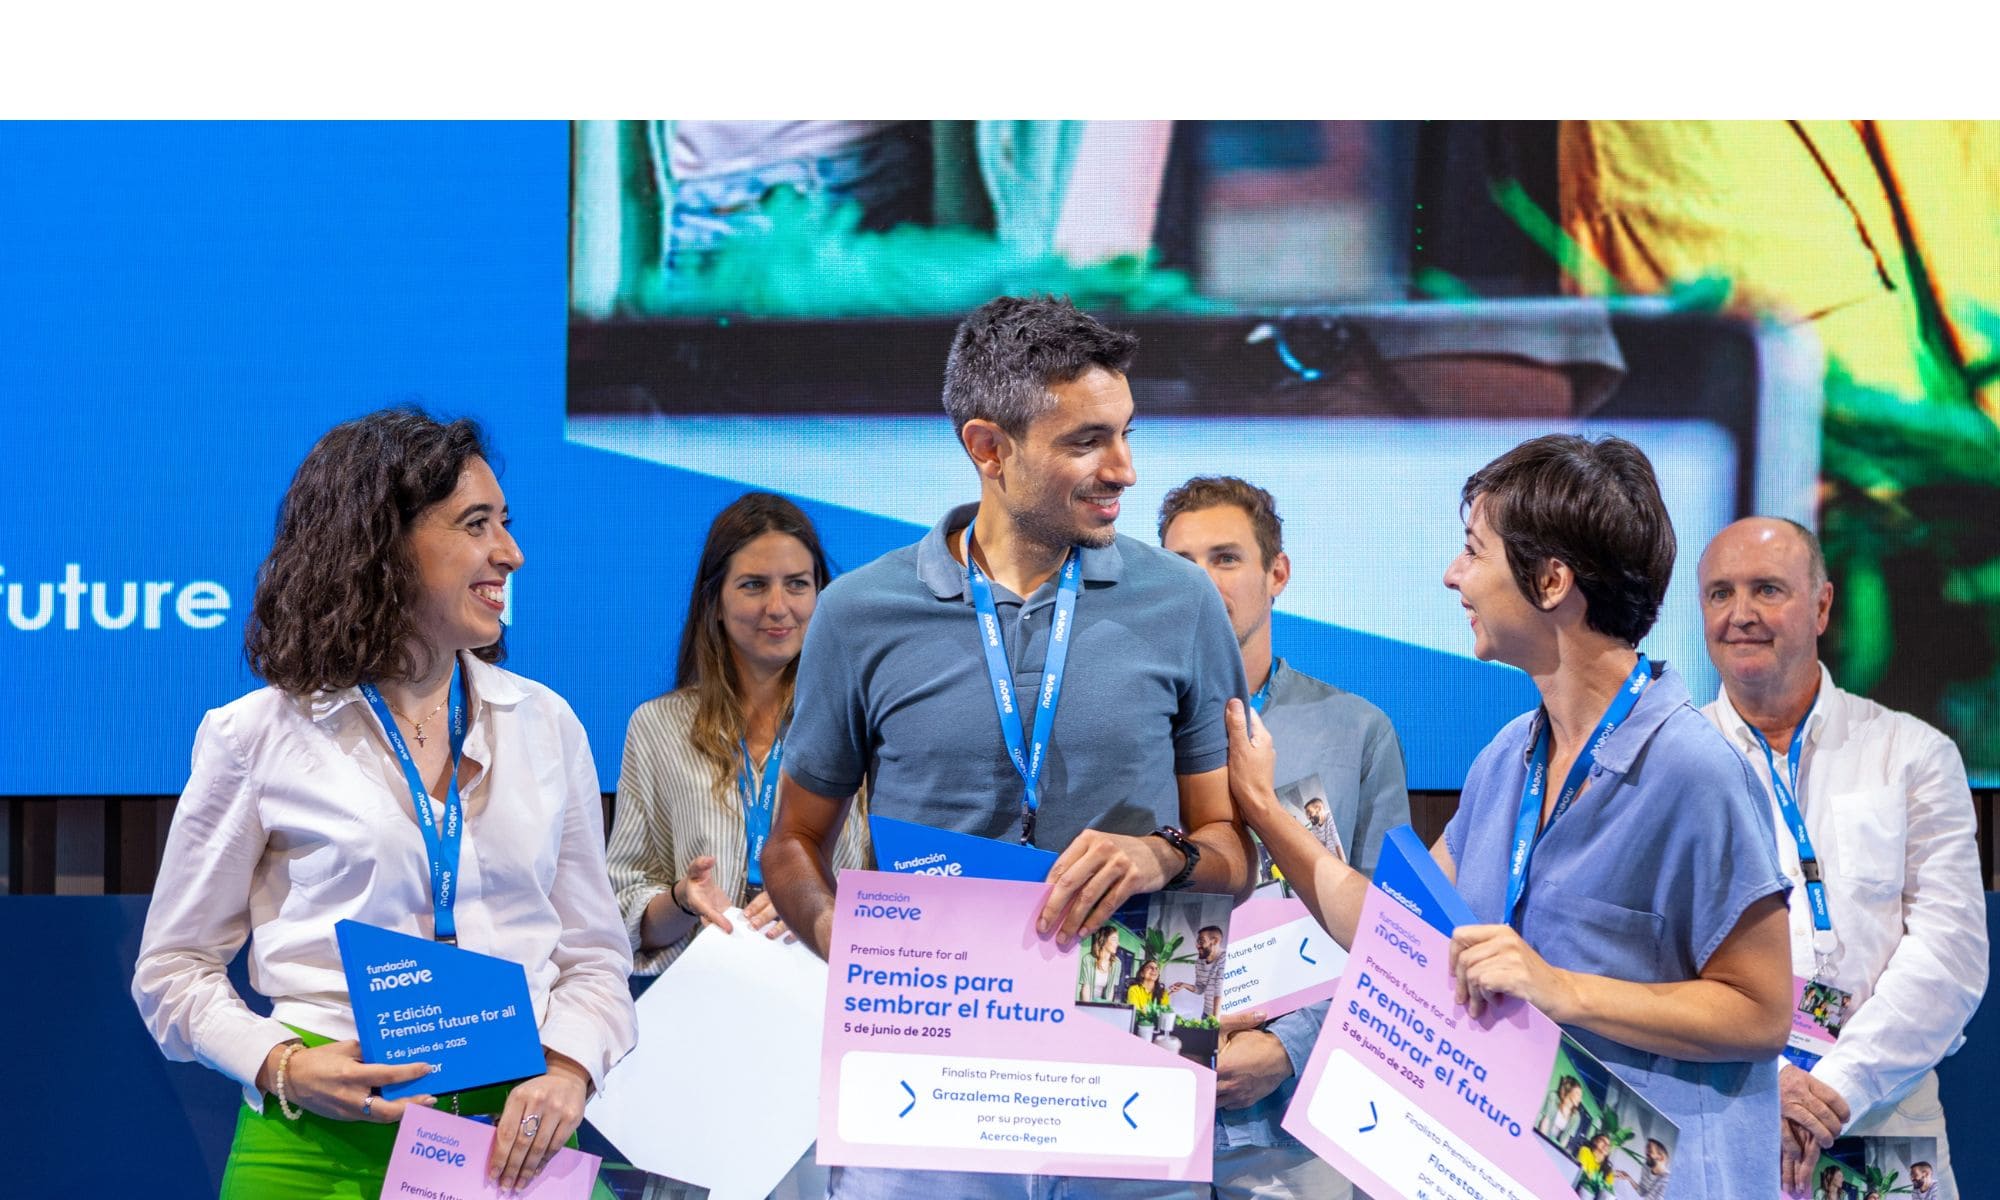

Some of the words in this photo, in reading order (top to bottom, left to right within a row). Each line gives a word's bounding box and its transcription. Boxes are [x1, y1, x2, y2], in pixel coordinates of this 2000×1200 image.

[0, 563, 231, 630] uture
[984, 613, 998, 647] moeve
[1055, 609, 1067, 642] moeve
[360, 683, 378, 704] oeve
[999, 679, 1013, 714] moeve
[1042, 673, 1056, 709] moeve
[389, 731, 410, 761] moeve
[1031, 742, 1041, 777] moeve
[1014, 748, 1027, 777] moev
[1530, 762, 1544, 796] moeve
[417, 792, 432, 826] moeve
[448, 804, 458, 837] moeve
[894, 853, 947, 871] fundación
[1512, 840, 1526, 875] moeve
[442, 871, 451, 906] moeve
[857, 890, 910, 902] fundación
[1382, 881, 1423, 917] fundación
[854, 905, 921, 921] moeve
[1378, 911, 1422, 946] fundación
[850, 944, 895, 956] Premios
[898, 947, 933, 959] future
[936, 949, 952, 960] for
[954, 951, 968, 961] all
[1227, 947, 1253, 960] future
[1253, 942, 1266, 951] for
[1266, 937, 1277, 946] all
[1375, 924, 1428, 968] moeve
[366, 959, 417, 975] fundación
[370, 969, 433, 992] moeve
[847, 963, 948, 989] Premios
[954, 974, 1013, 995] para
[1223, 978, 1260, 996] proyecto
[1366, 956, 1401, 988] Premios
[1402, 983, 1430, 1009] future
[1430, 1005, 1445, 1019] for
[1445, 1015, 1457, 1029] all
[381, 1022, 435, 1040] Premios
[439, 1015, 479, 1030] future
[481, 1009, 498, 1022] for
[502, 1005, 516, 1018] all
[394, 1004, 442, 1022] Edición
[844, 994, 952, 1017] sembrar
[958, 999, 979, 1018] el
[986, 999, 1065, 1024] futuro
[844, 1022, 851, 1033] 5
[854, 1023, 869, 1034] de
[870, 1024, 901, 1037] junio
[903, 1025, 918, 1037] de
[921, 1026, 951, 1038] 2025
[1356, 972, 1435, 1043] Premios
[1436, 1038, 1488, 1083] para
[386, 1050, 393, 1060] 5
[394, 1048, 406, 1058] de
[407, 1044, 431, 1058] junio
[432, 1042, 444, 1051] de
[445, 1037, 468, 1050] 2025
[1342, 1021, 1350, 1032] 5
[1349, 1027, 1362, 1042] de
[1361, 1038, 1386, 1061] junio
[1387, 1052, 1400, 1070] de
[1400, 1066, 1425, 1090] 2025
[942, 1067, 987, 1080] Finalista
[989, 1069, 1032, 1082] Premios
[1035, 1072, 1068, 1084] future
[1071, 1073, 1086, 1084] for
[1088, 1075, 1101, 1085] all
[1348, 1000, 1432, 1068] sembrar
[1434, 1065, 1455, 1087] el
[1457, 1078, 1522, 1138] futuro
[932, 1088, 1010, 1104] Grazalema
[1014, 1092, 1108, 1108] Regenerativa
[977, 1114, 996, 1124] por
[998, 1115, 1011, 1124] su
[1013, 1115, 1062, 1127] proyecto
[417, 1127, 459, 1148] fundación
[980, 1131, 1057, 1145] Acerca-Regen
[410, 1142, 466, 1167] moeve
[1404, 1112, 1442, 1145] Finalista
[1442, 1140, 1477, 1172] Premios
[1478, 1168, 1506, 1194] future
[401, 1181, 438, 1200] Premios
